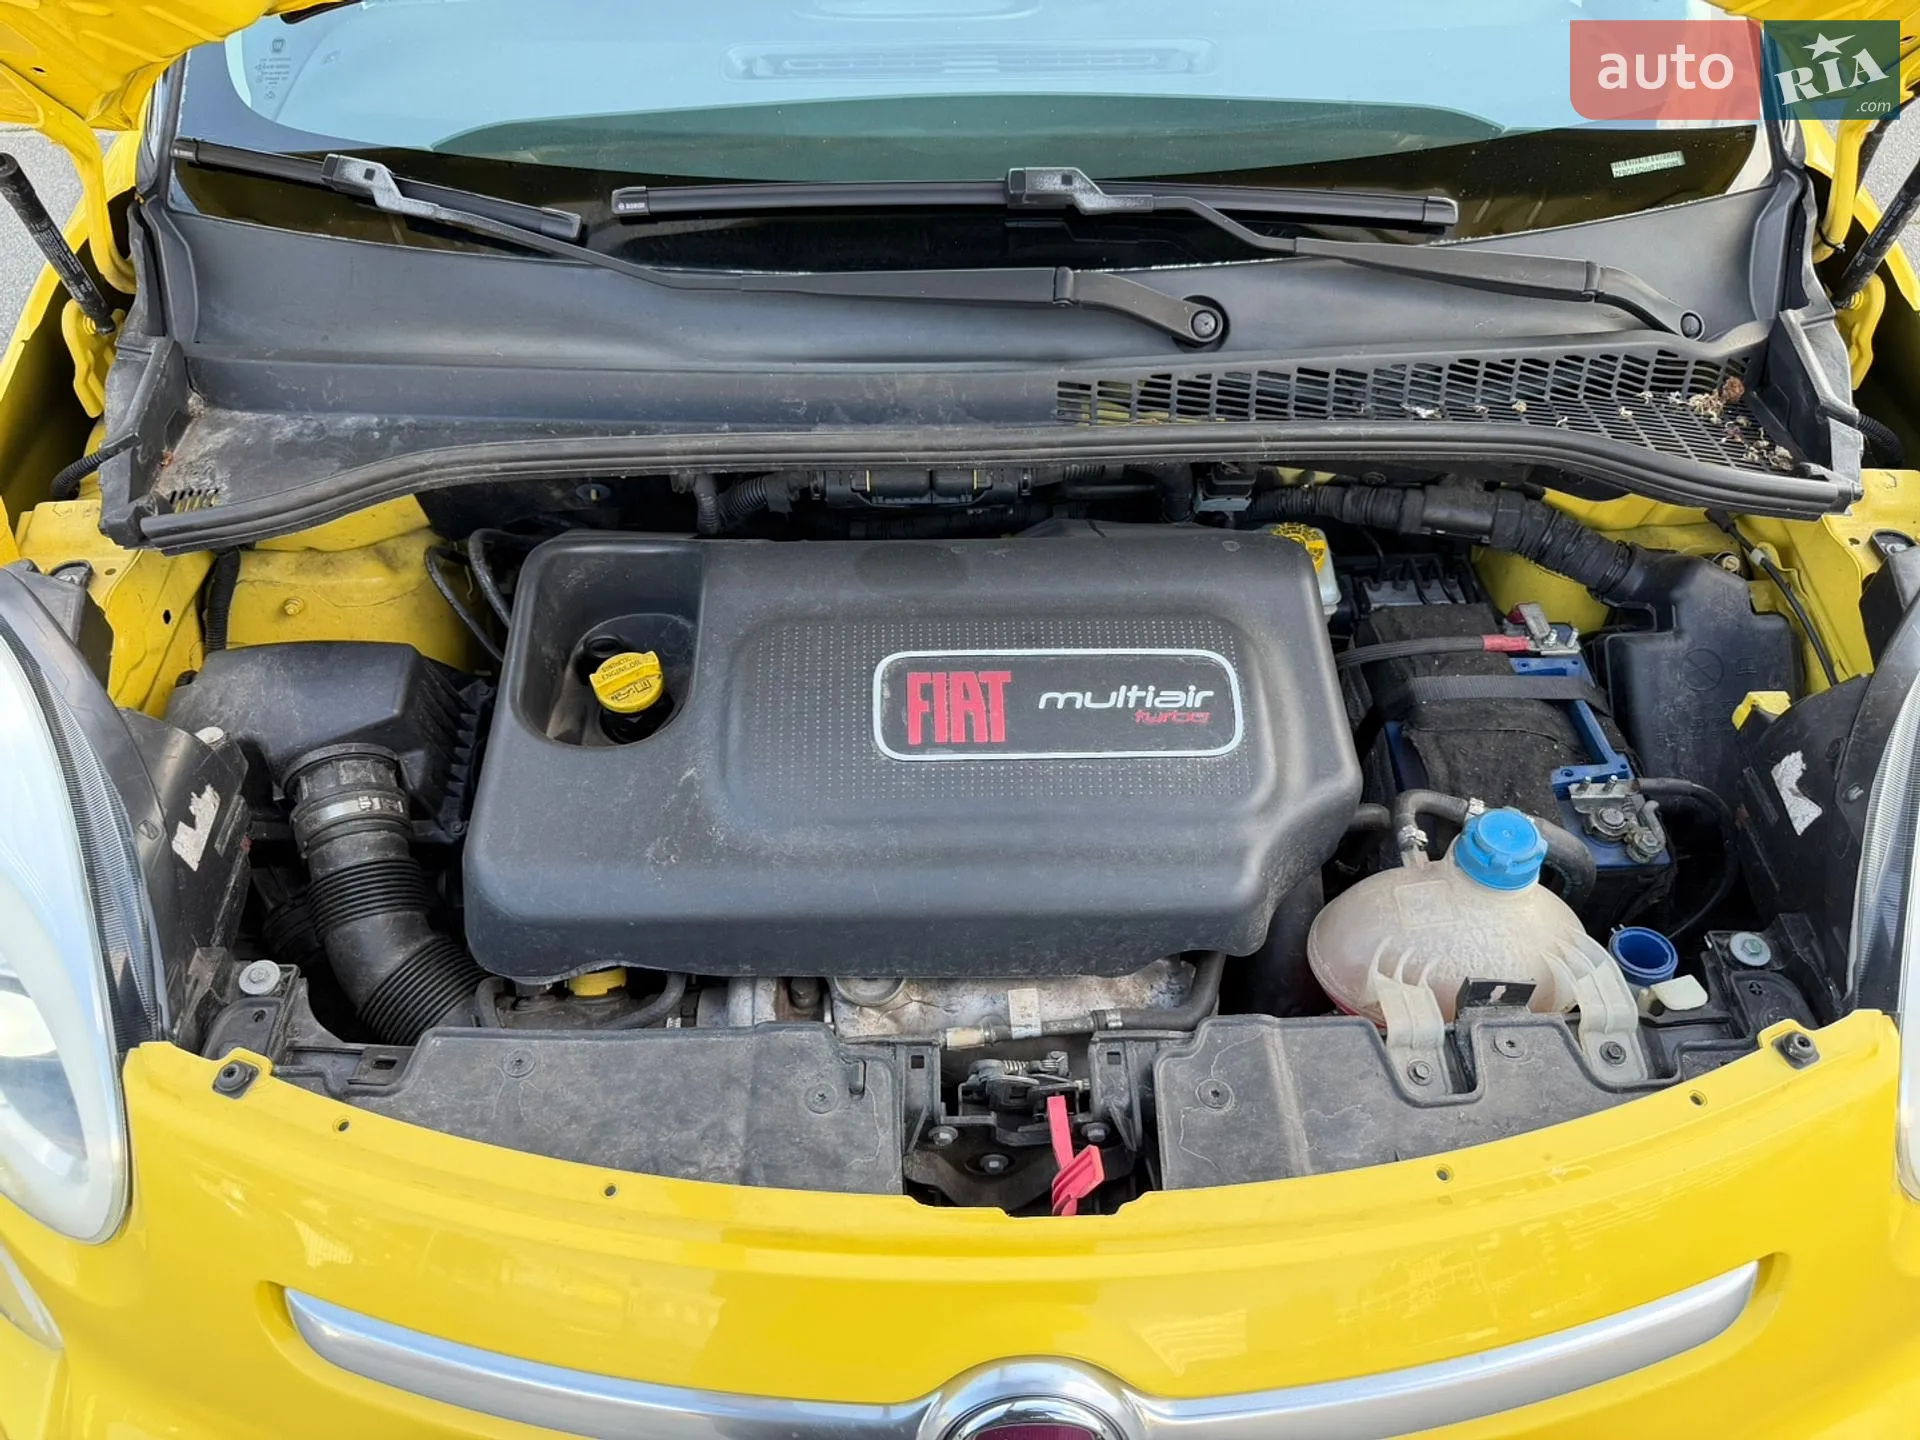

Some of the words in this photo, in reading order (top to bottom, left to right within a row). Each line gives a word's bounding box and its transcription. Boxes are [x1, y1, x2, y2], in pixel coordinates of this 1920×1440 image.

[906, 670, 1012, 745] FIAT
[1038, 685, 1214, 709] multiair
[1134, 708, 1210, 726] turbo
